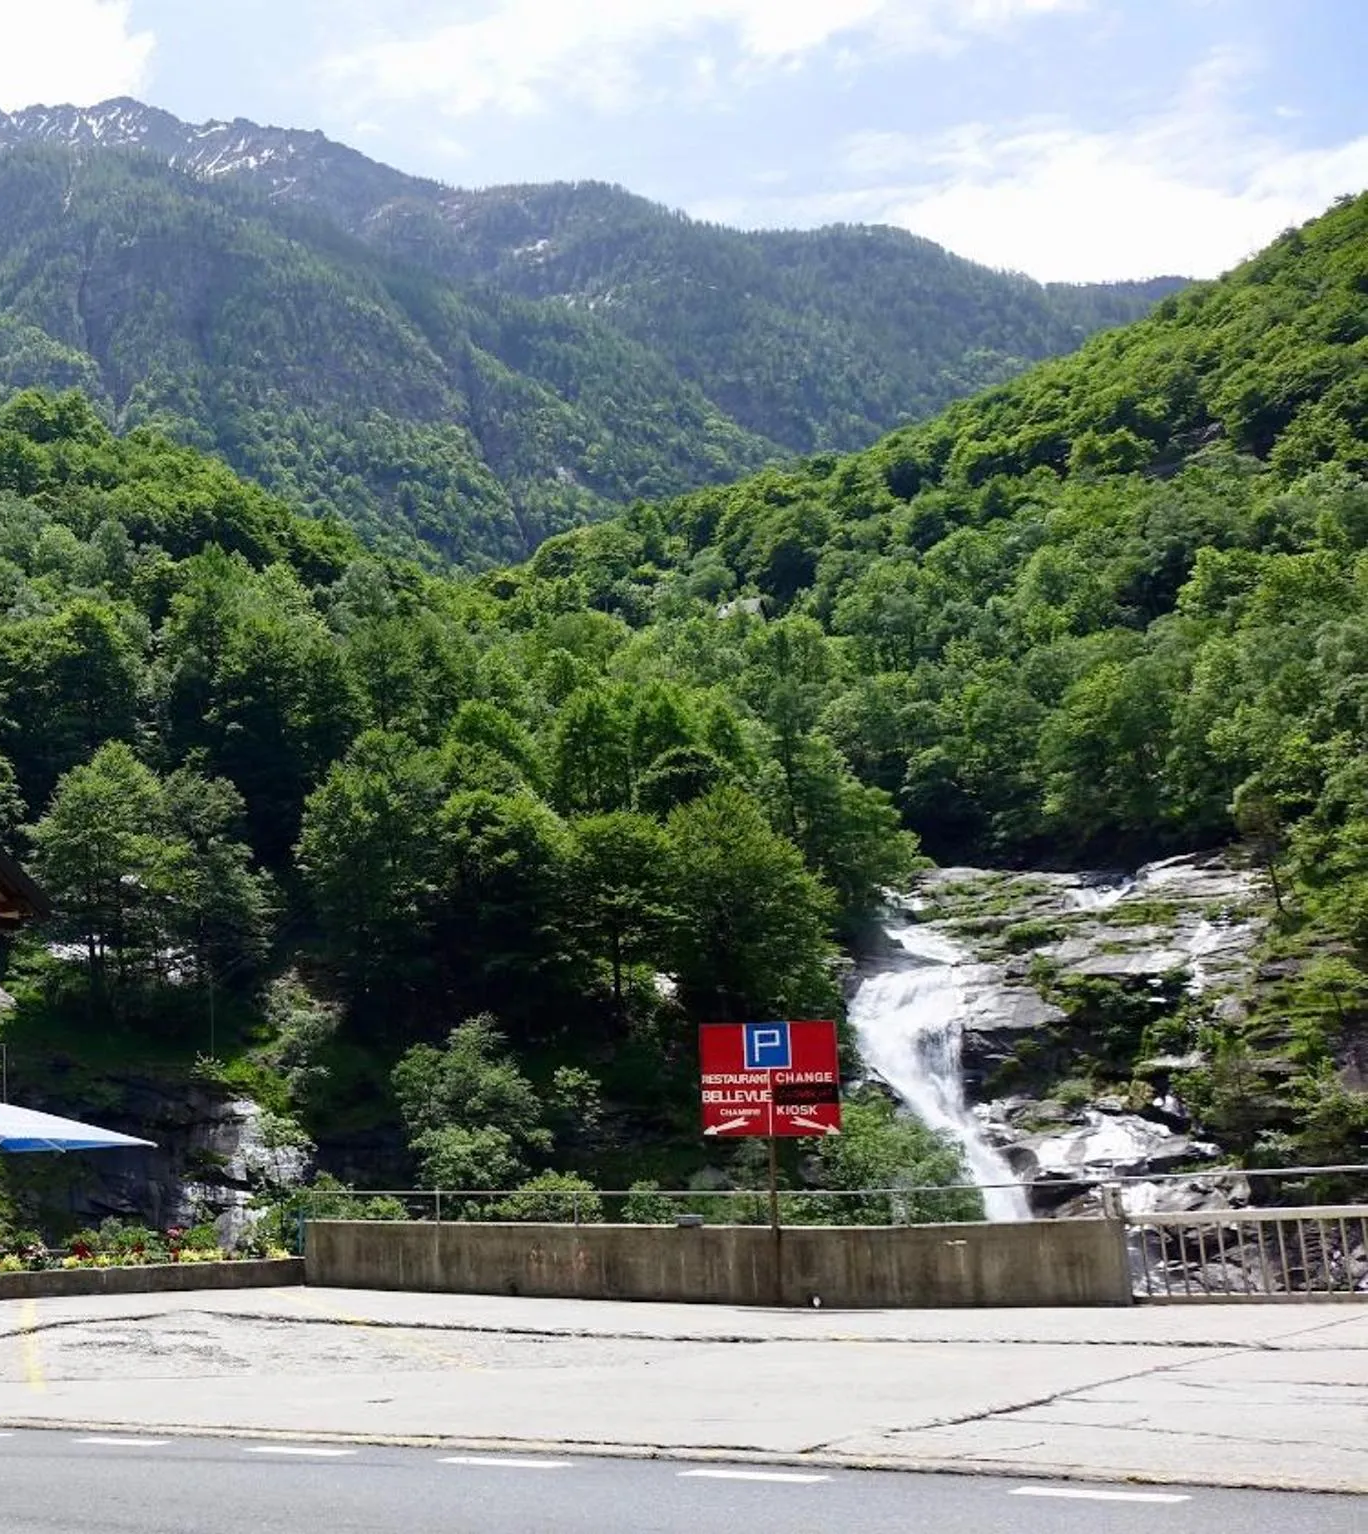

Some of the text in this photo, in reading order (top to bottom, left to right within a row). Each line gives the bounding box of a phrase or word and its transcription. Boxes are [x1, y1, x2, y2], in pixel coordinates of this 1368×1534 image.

[753, 1030, 781, 1063] P
[701, 1073, 768, 1084] RESTAURANT
[775, 1072, 833, 1083] CHANGE
[701, 1089, 772, 1103] BELLEVUE
[776, 1104, 819, 1116] KIOSK
